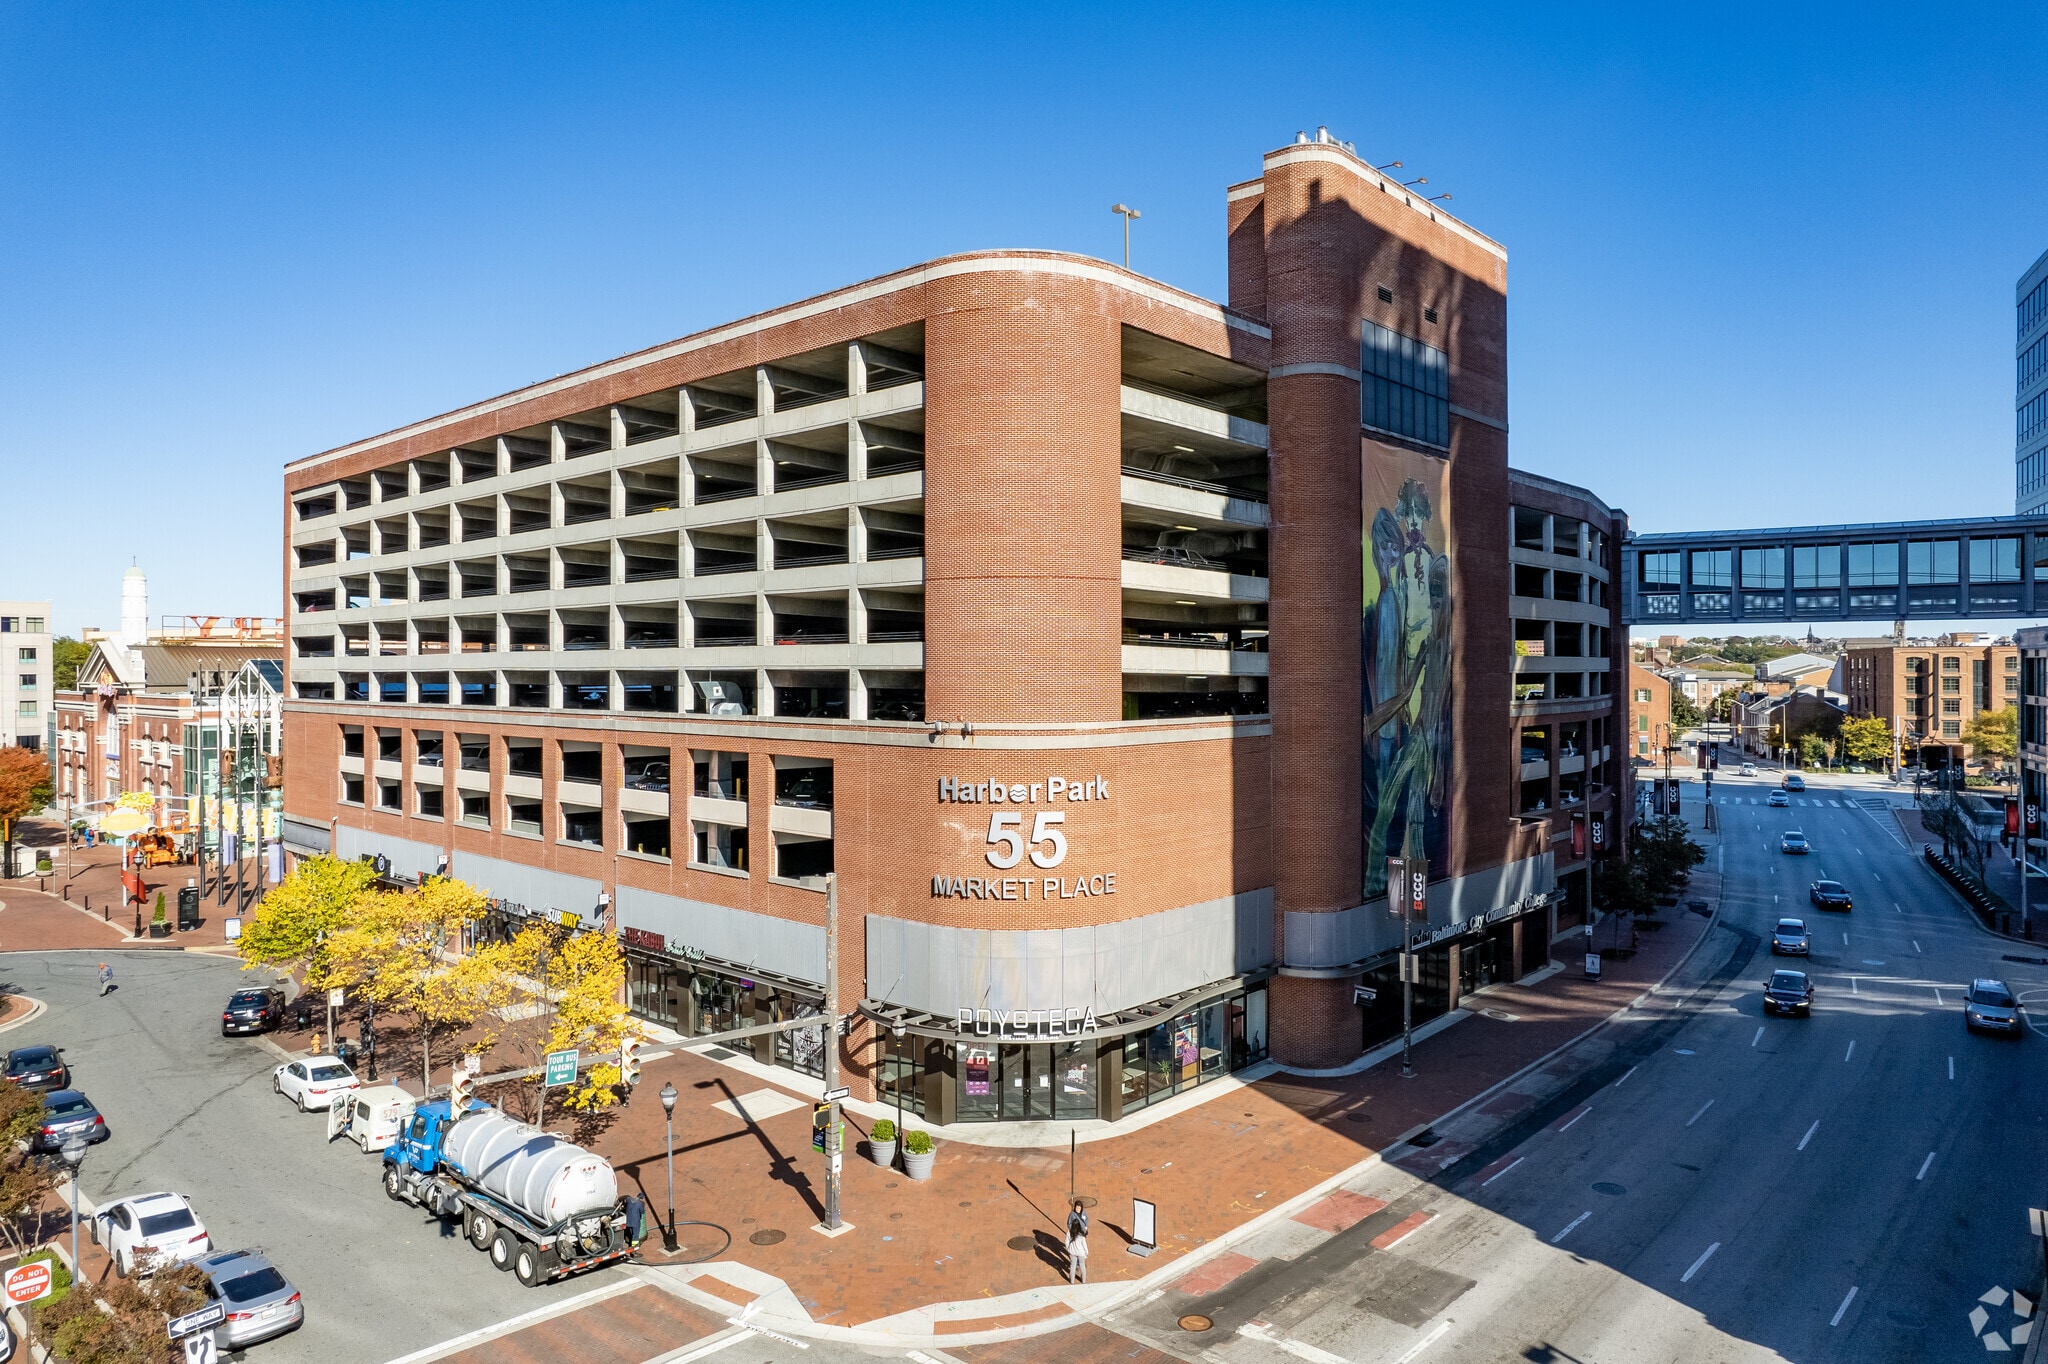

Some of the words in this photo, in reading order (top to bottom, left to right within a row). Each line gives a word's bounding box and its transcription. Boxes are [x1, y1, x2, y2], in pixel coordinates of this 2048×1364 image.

[939, 775, 1043, 803] Harbor
[1046, 774, 1110, 803] Park
[985, 811, 1068, 870] 55
[930, 873, 1035, 900] MARKET
[1042, 872, 1118, 900] PLACE
[1413, 872, 1423, 910] BCCC
[547, 908, 581, 929] SUBWAY
[1431, 920, 1468, 943] Baltimore
[1469, 914, 1485, 930] City
[1486, 900, 1524, 923] Community
[1524, 892, 1548, 909] College
[624, 926, 640, 944] THE
[639, 929, 665, 951] KABUL
[958, 1006, 1098, 1037] POYOTECA
[549, 1055, 564, 1065] TOUR
[565, 1053, 577, 1063] BUS
[550, 1062, 574, 1073] PARKING
[383, 1108, 398, 1119] $79
[12, 1273, 24, 1283] DO
[27, 1267, 44, 1278] NOT
[15, 1284, 41, 1298] ENTER
[185, 1316, 200, 1327] ONE
[202, 1309, 218, 1321] WAY
